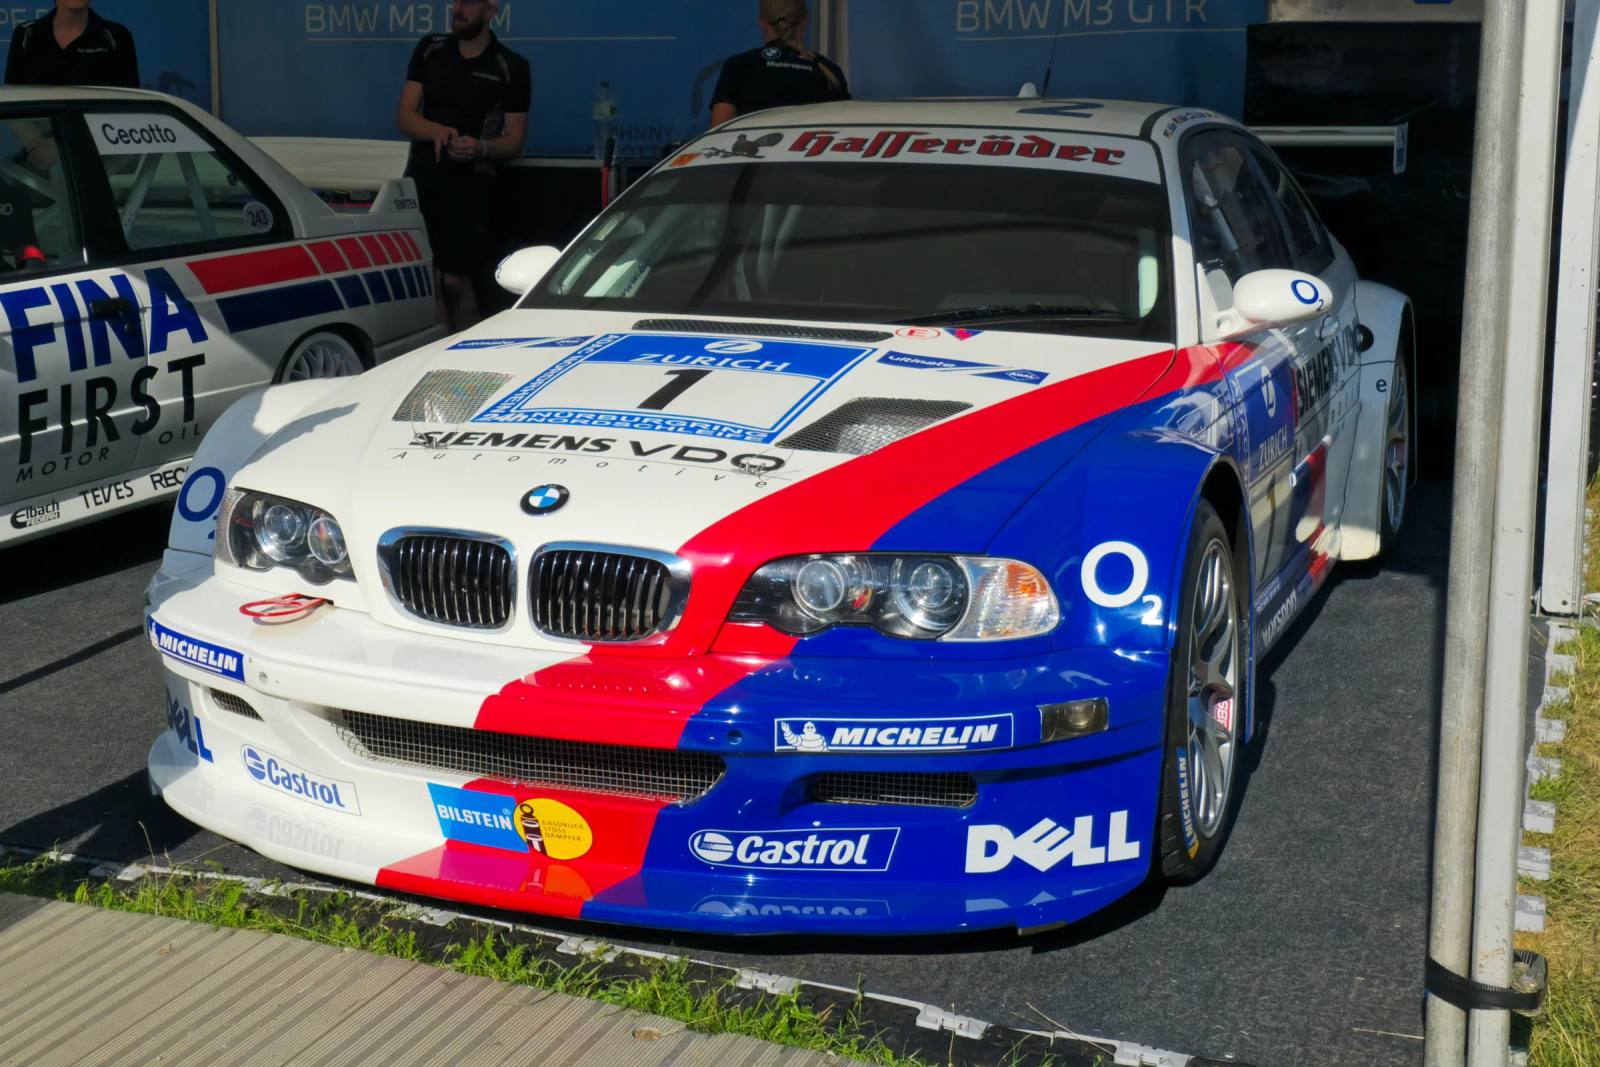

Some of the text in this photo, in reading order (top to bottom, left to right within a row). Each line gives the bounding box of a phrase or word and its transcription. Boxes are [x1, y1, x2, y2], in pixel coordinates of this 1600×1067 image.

[305, 4, 379, 33] BMW
[389, 4, 434, 33] M3
[957, 0, 1208, 33] BMW M3 GTR
[101, 123, 177, 145] Cecotto
[247, 209, 269, 227] 243
[2, 267, 209, 383] FINA
[629, 353, 793, 373] ZURICH
[887, 354, 957, 370] ultimate
[17, 352, 207, 466] FIRST
[636, 366, 714, 412] 1
[15, 446, 111, 485] MOTOR
[408, 429, 787, 474] SIEMENS VDO
[1258, 424, 1289, 472] ZURICH
[78, 464, 191, 511] TEVES REC
[159, 631, 239, 673] MICHELIN
[165, 682, 214, 764] DELL
[830, 723, 999, 746] MICHELIN
[266, 757, 346, 809] Castrol
[1177, 756, 1199, 838] MICHELIN
[436, 803, 514, 831] BILSTEIN
[735, 834, 868, 865] Castrol
[964, 810, 1141, 873] DELL
